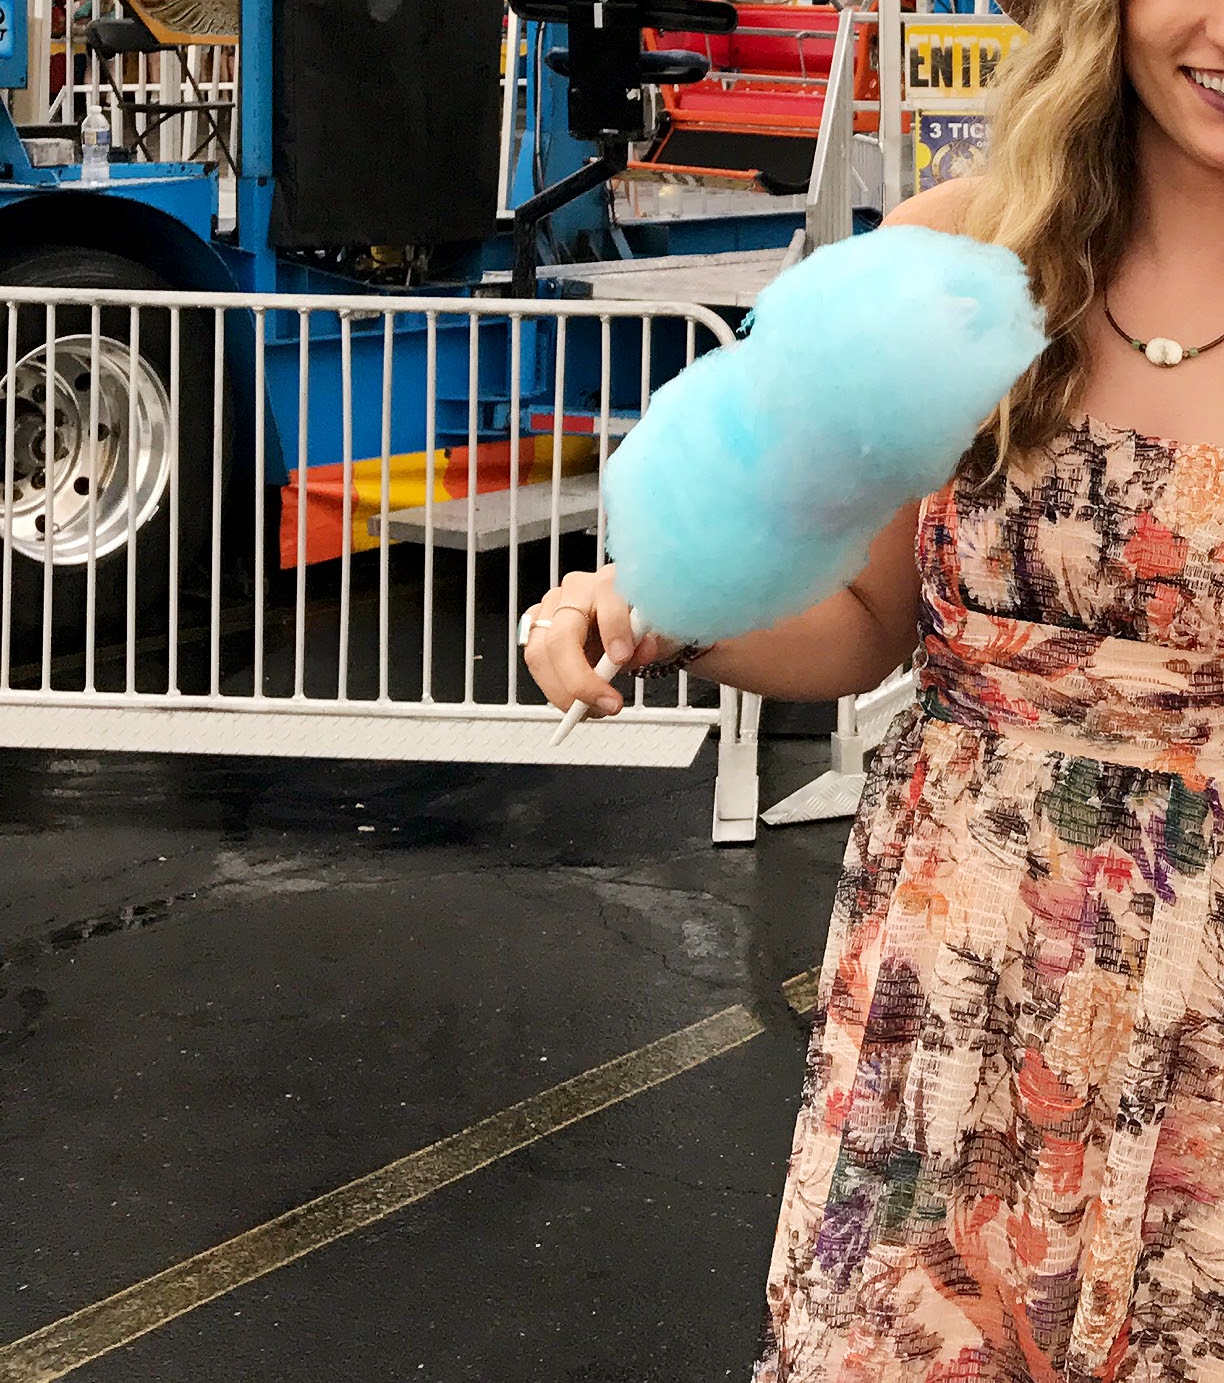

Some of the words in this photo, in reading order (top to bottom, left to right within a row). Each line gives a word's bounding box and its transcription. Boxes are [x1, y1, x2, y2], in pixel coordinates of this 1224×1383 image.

[909, 34, 1022, 88] ENTR
[929, 122, 942, 139] 3
[948, 122, 990, 139] TIC
